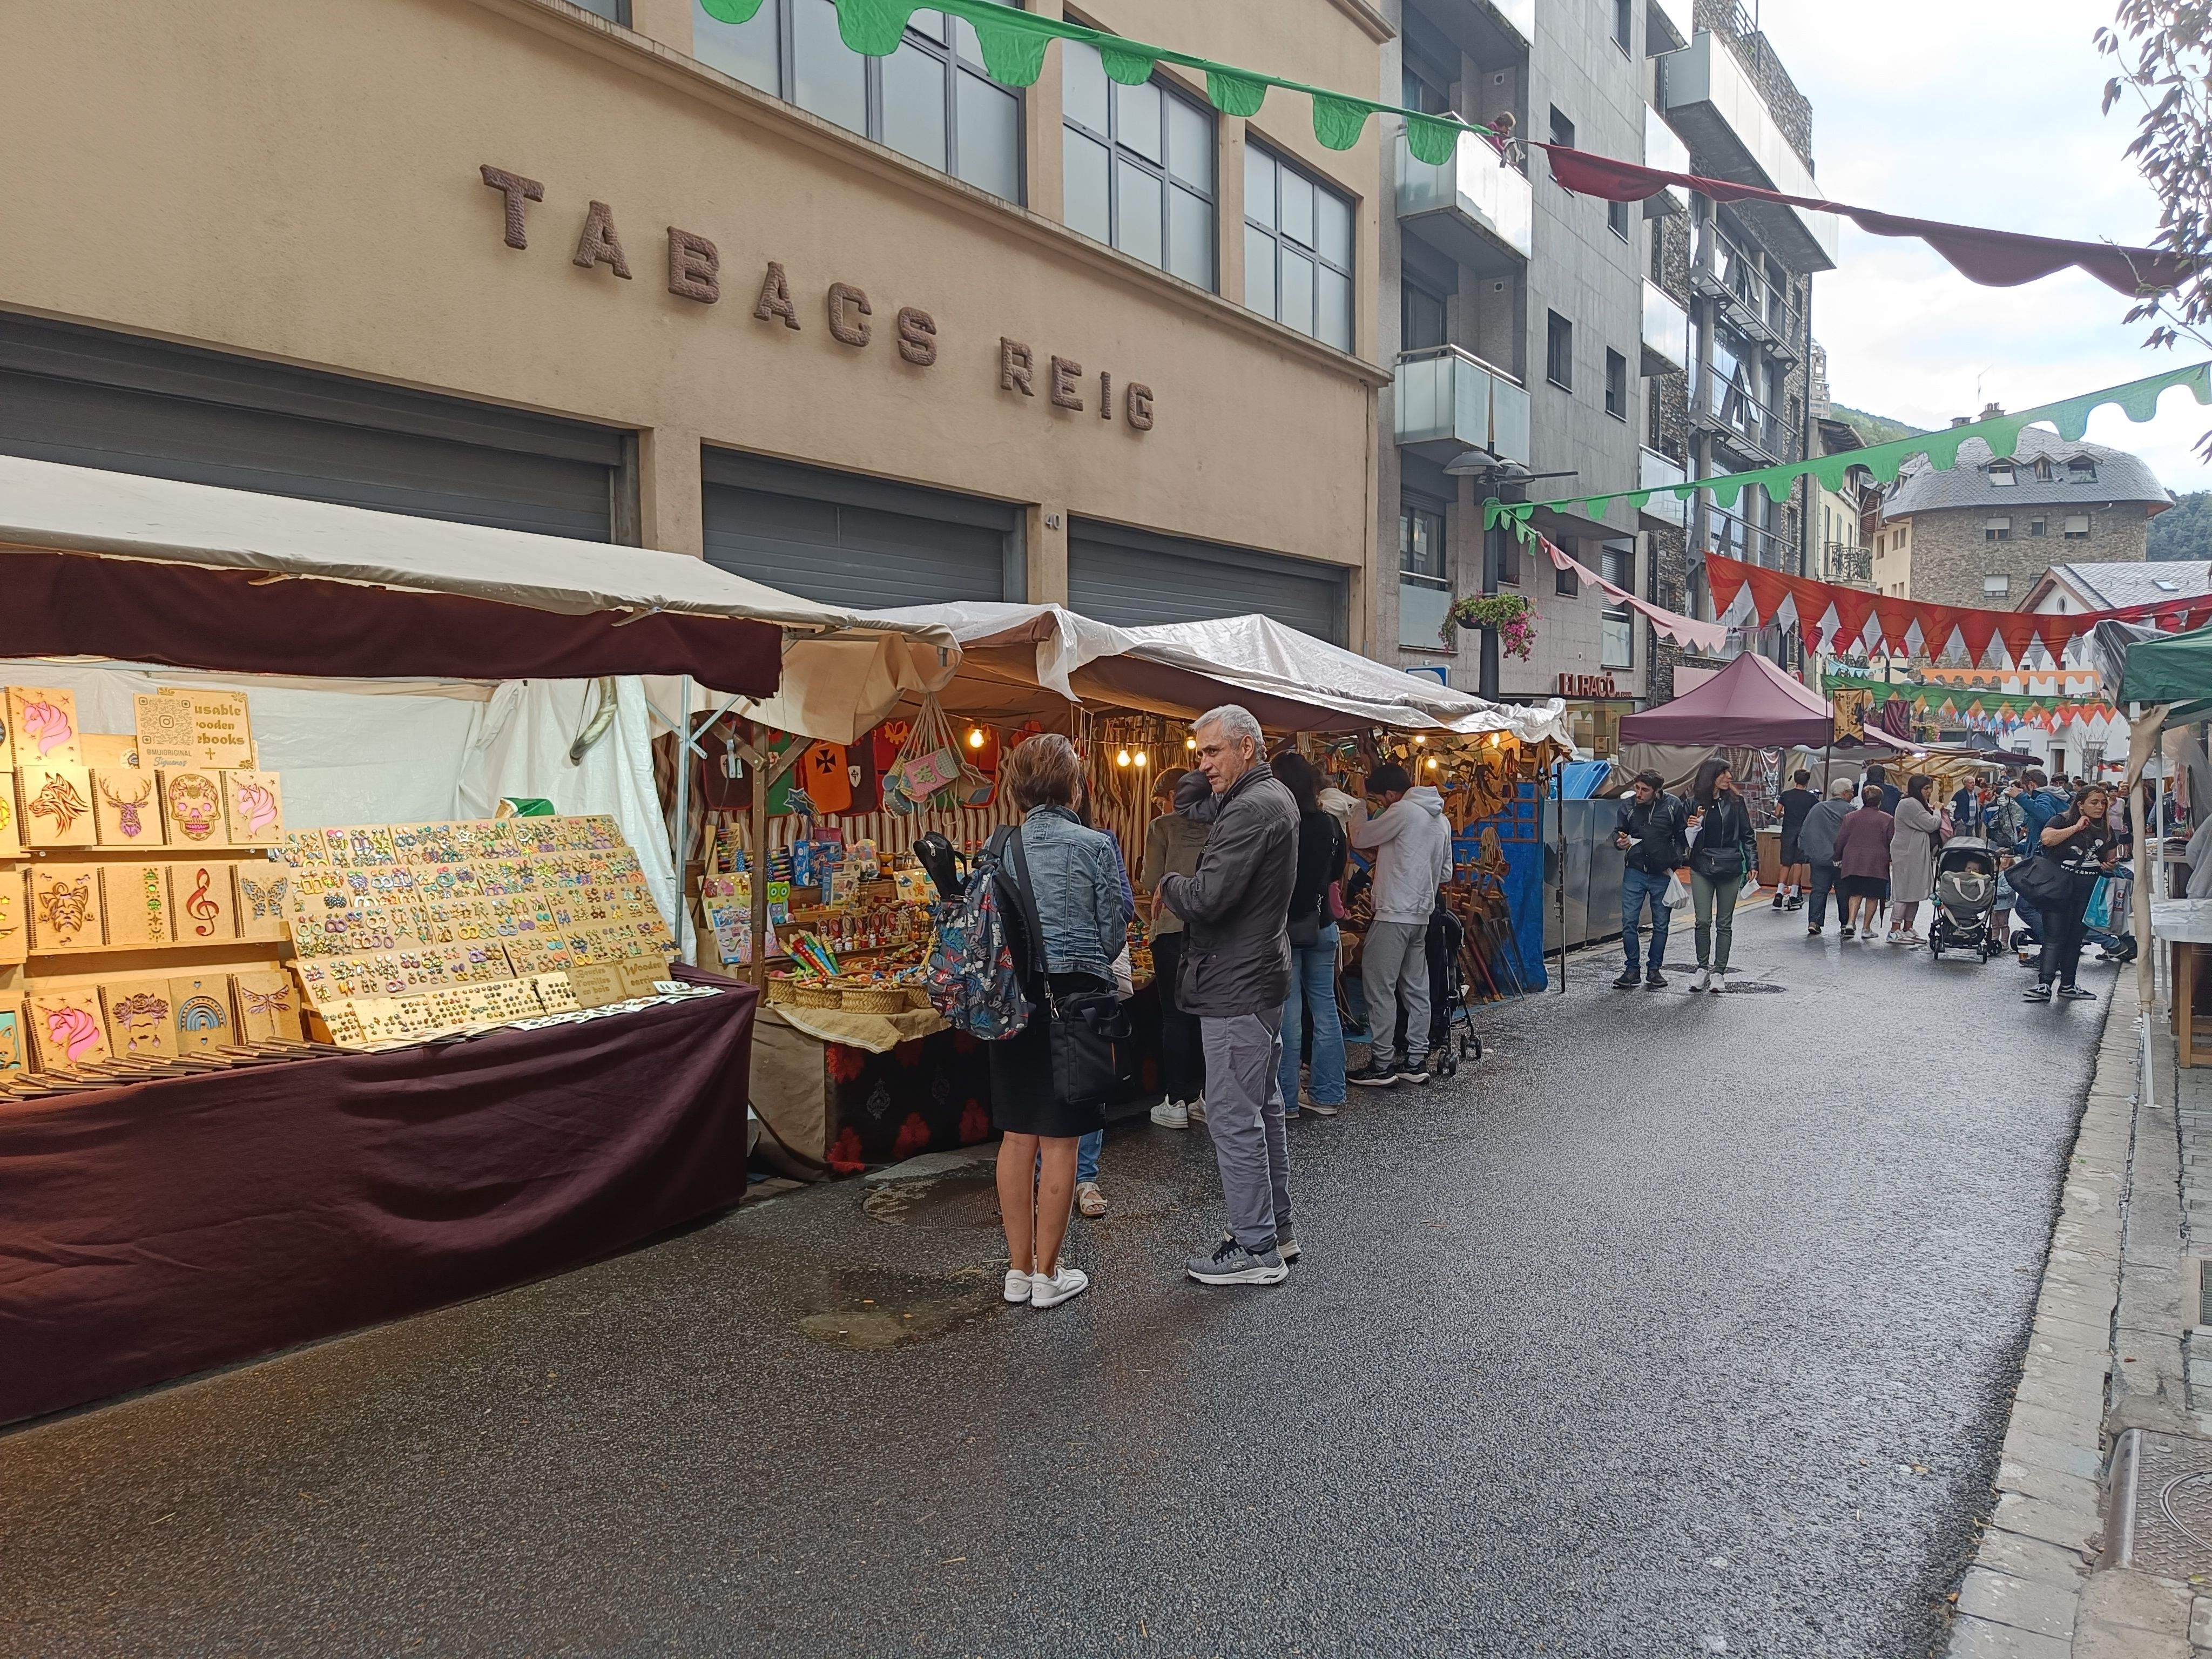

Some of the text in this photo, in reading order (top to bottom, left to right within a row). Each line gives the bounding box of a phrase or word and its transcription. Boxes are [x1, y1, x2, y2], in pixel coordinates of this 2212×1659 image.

[479, 164, 1155, 431] TABACS REIG
[1046, 514, 1062, 529] 40
[1560, 673, 1580, 696] EL
[196, 720, 234, 730] ooden
[575, 967, 606, 979] Boucles
[623, 961, 662, 976] Wooden
[594, 986, 610, 994] bois
